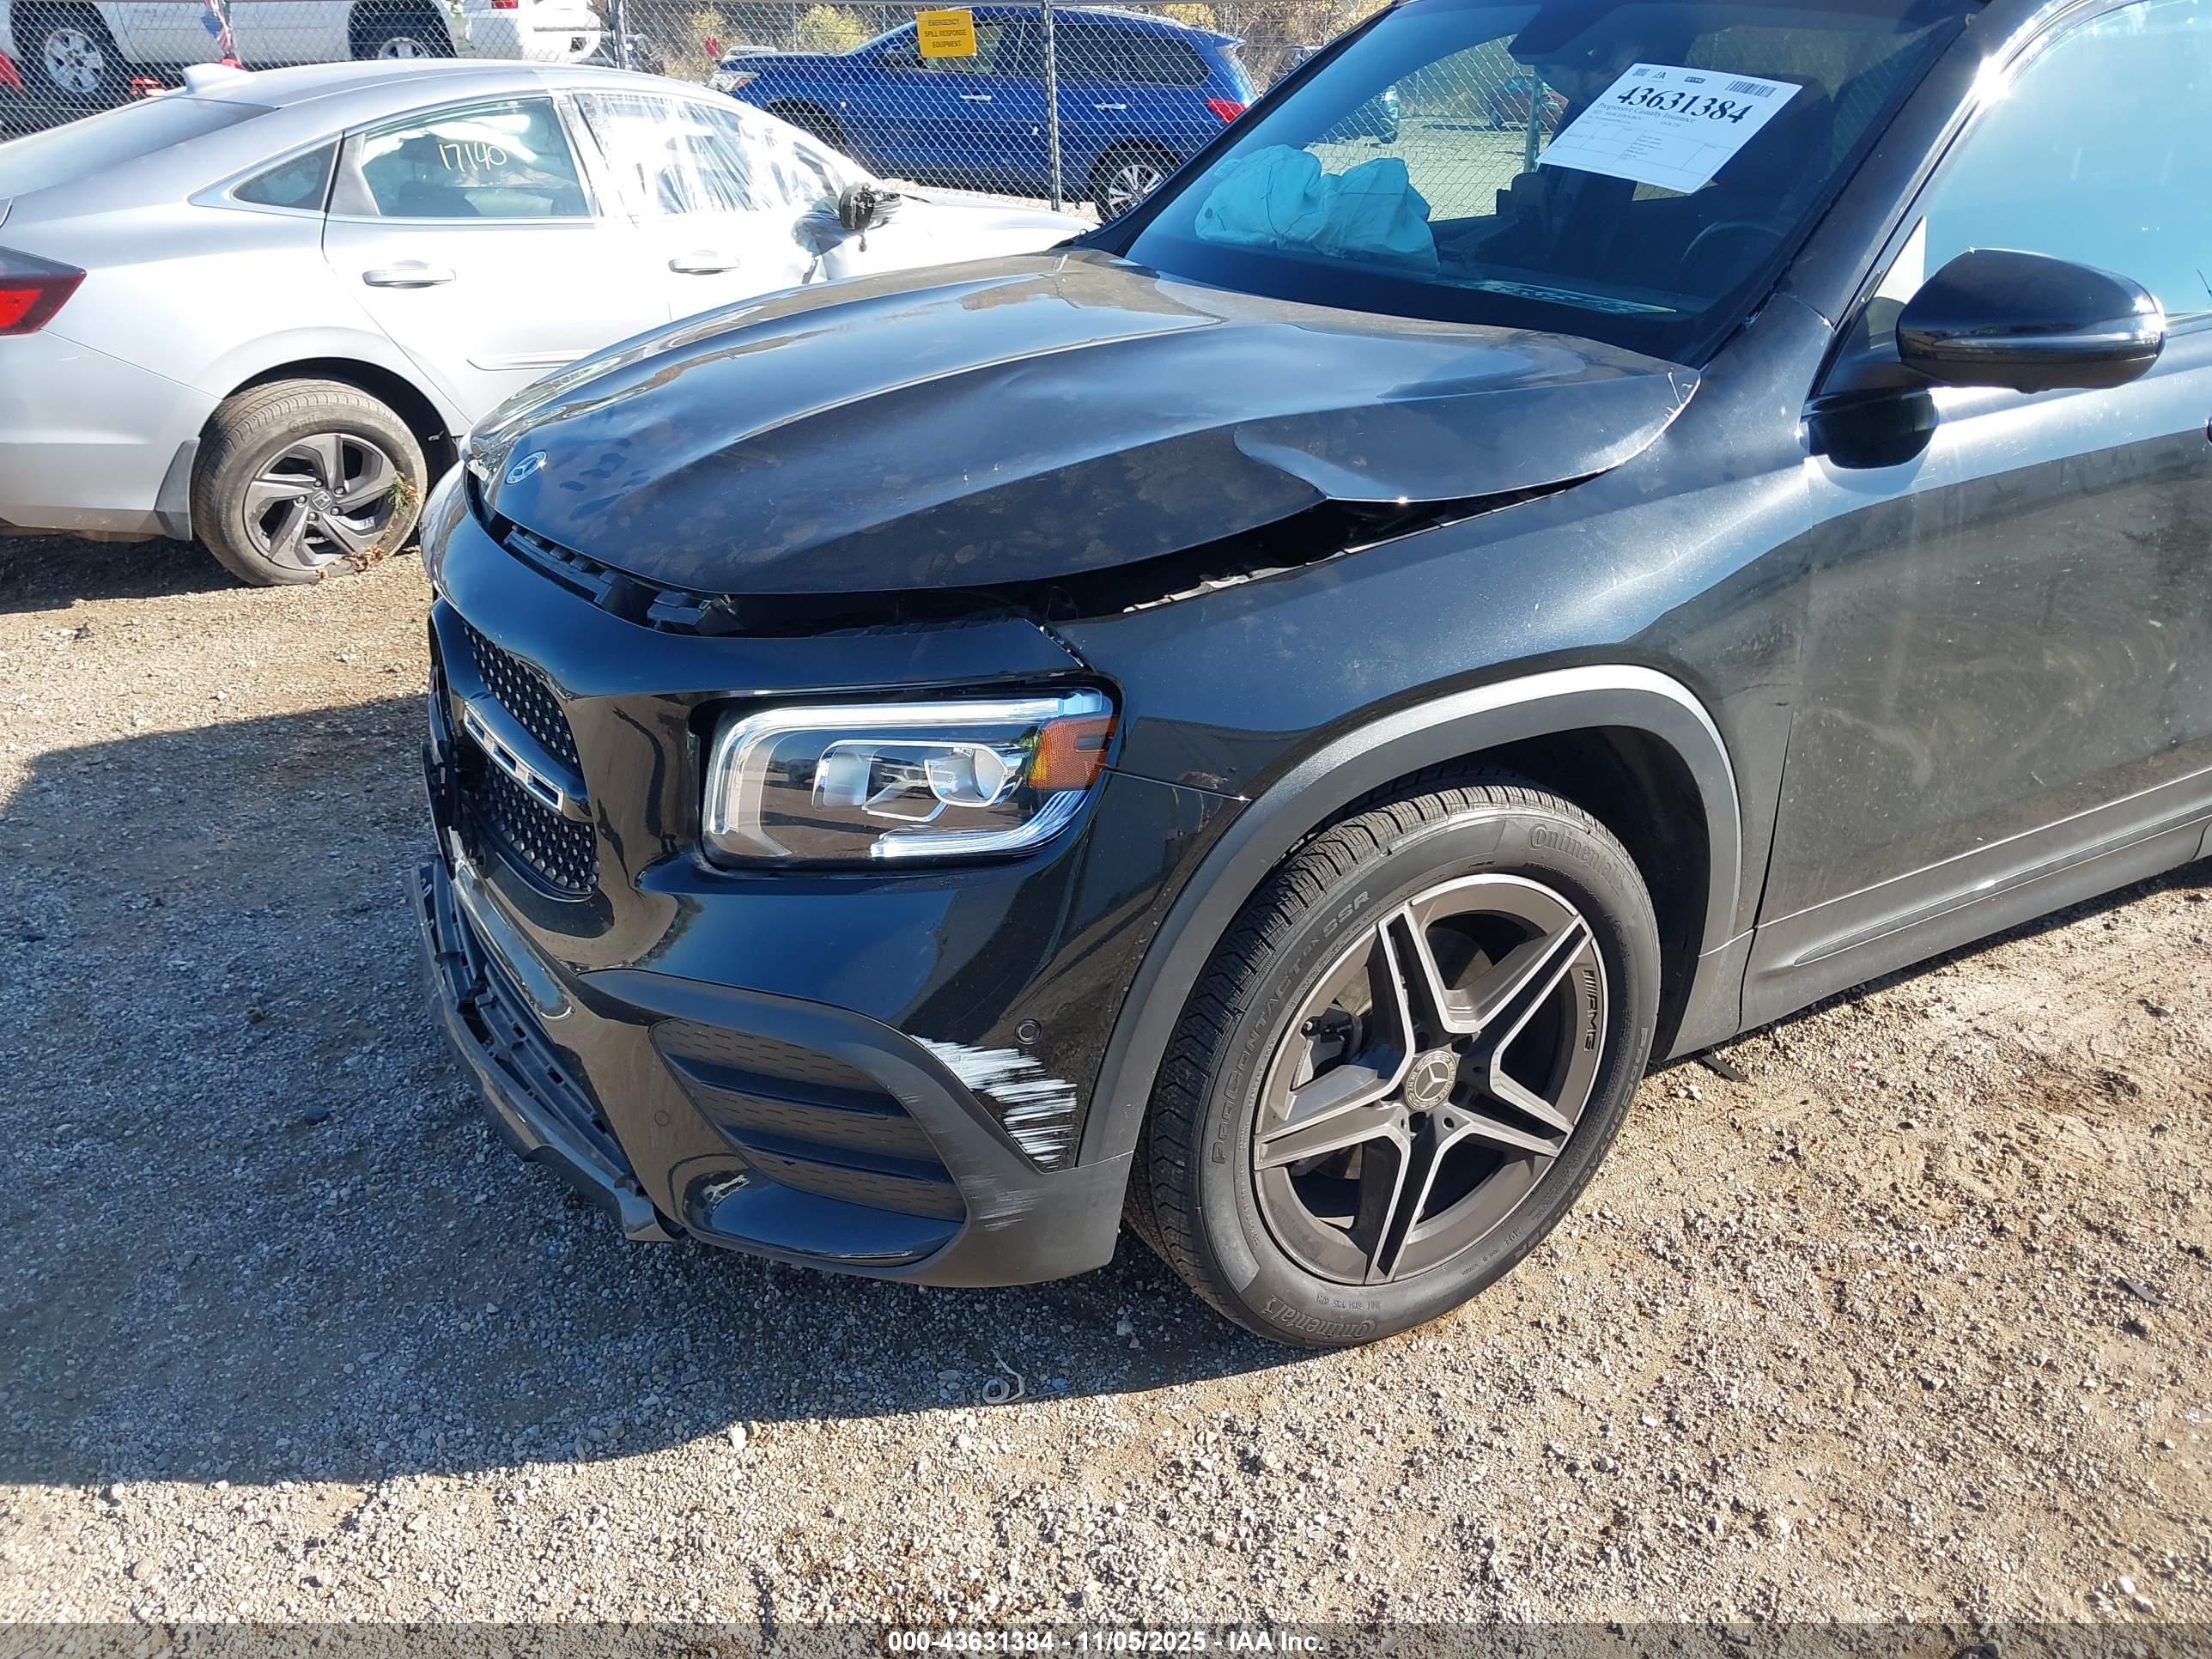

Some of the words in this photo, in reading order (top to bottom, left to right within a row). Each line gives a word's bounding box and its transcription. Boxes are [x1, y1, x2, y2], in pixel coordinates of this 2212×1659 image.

[1616, 86, 1754, 125] 43631384
[1662, 112, 1697, 124] Insurance
[438, 142, 507, 173] 17140
[1322, 890, 1370, 939] SSR
[1584, 993, 1598, 1052] AMG
